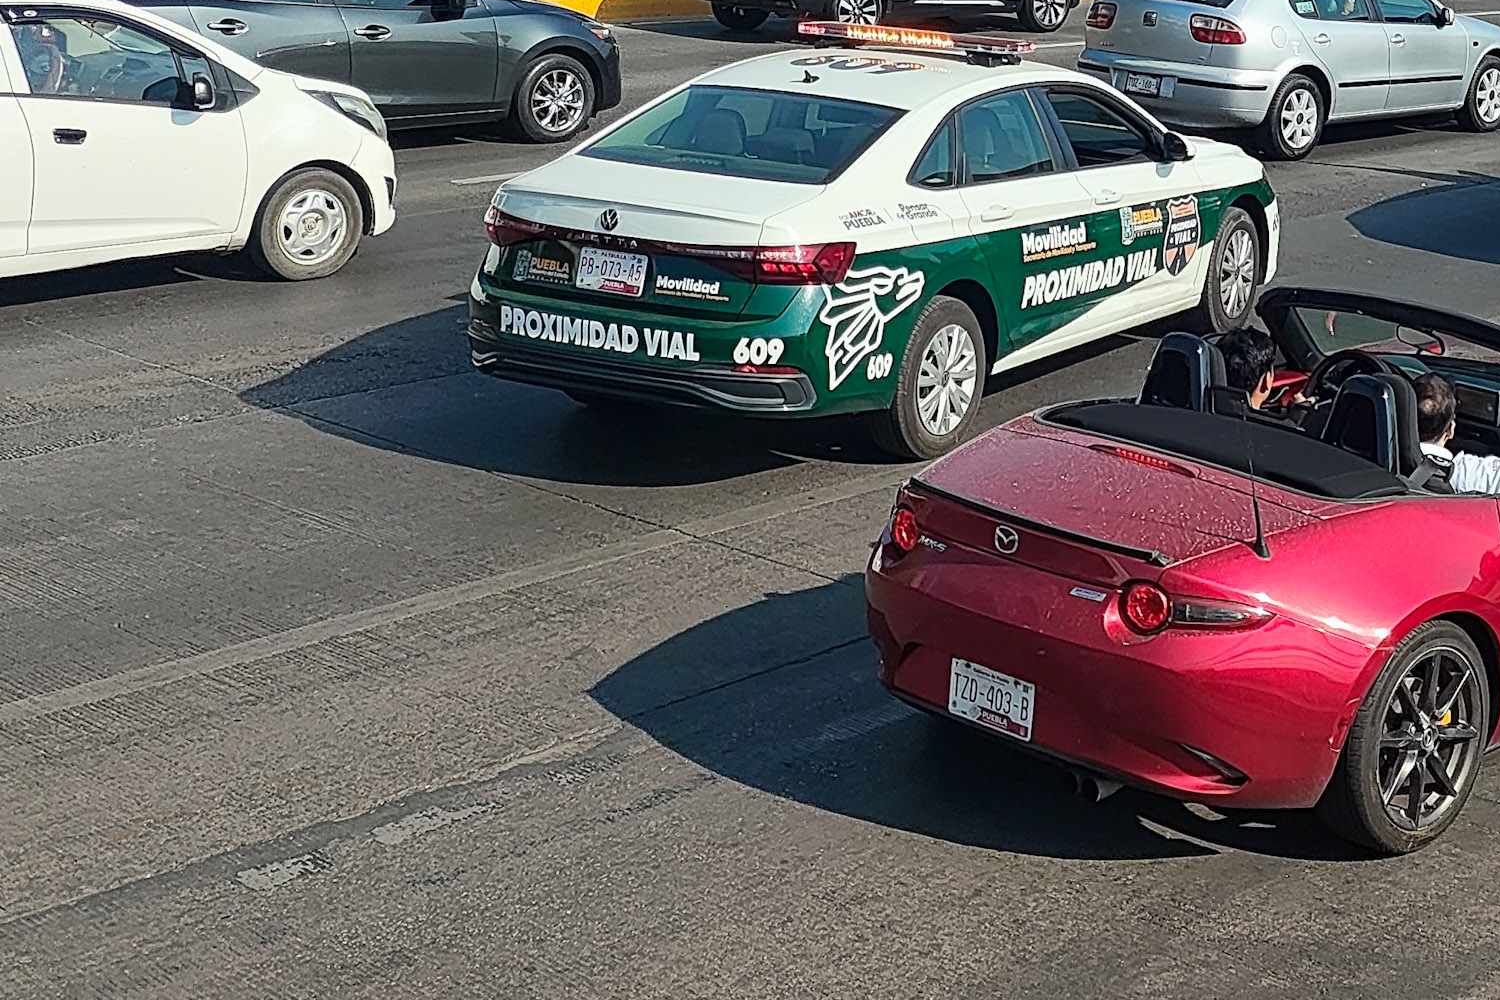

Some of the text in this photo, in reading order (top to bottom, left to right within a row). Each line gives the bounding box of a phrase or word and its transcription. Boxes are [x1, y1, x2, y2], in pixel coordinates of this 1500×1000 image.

[898, 203, 928, 212] Pensar
[906, 210, 938, 220] Grande
[1133, 208, 1162, 222] PUEBLA
[842, 215, 886, 230] PUEBLA
[580, 233, 638, 248] JETTA
[1021, 222, 1087, 254] Movilidad
[1174, 231, 1192, 246] VIAL
[530, 256, 570, 274] PUEBLA
[601, 252, 626, 260] PATRULLA
[580, 256, 643, 282] PB-073-A5
[656, 274, 720, 294] Movilidad
[1021, 248, 1158, 310] PROXIMIDAD VIAL
[500, 306, 700, 362] PROXIMIDAD VIAL
[733, 338, 785, 366] 609
[867, 352, 893, 381] 609
[954, 672, 1030, 721] TZD-403-B
[982, 712, 1008, 727] PUEBLA
